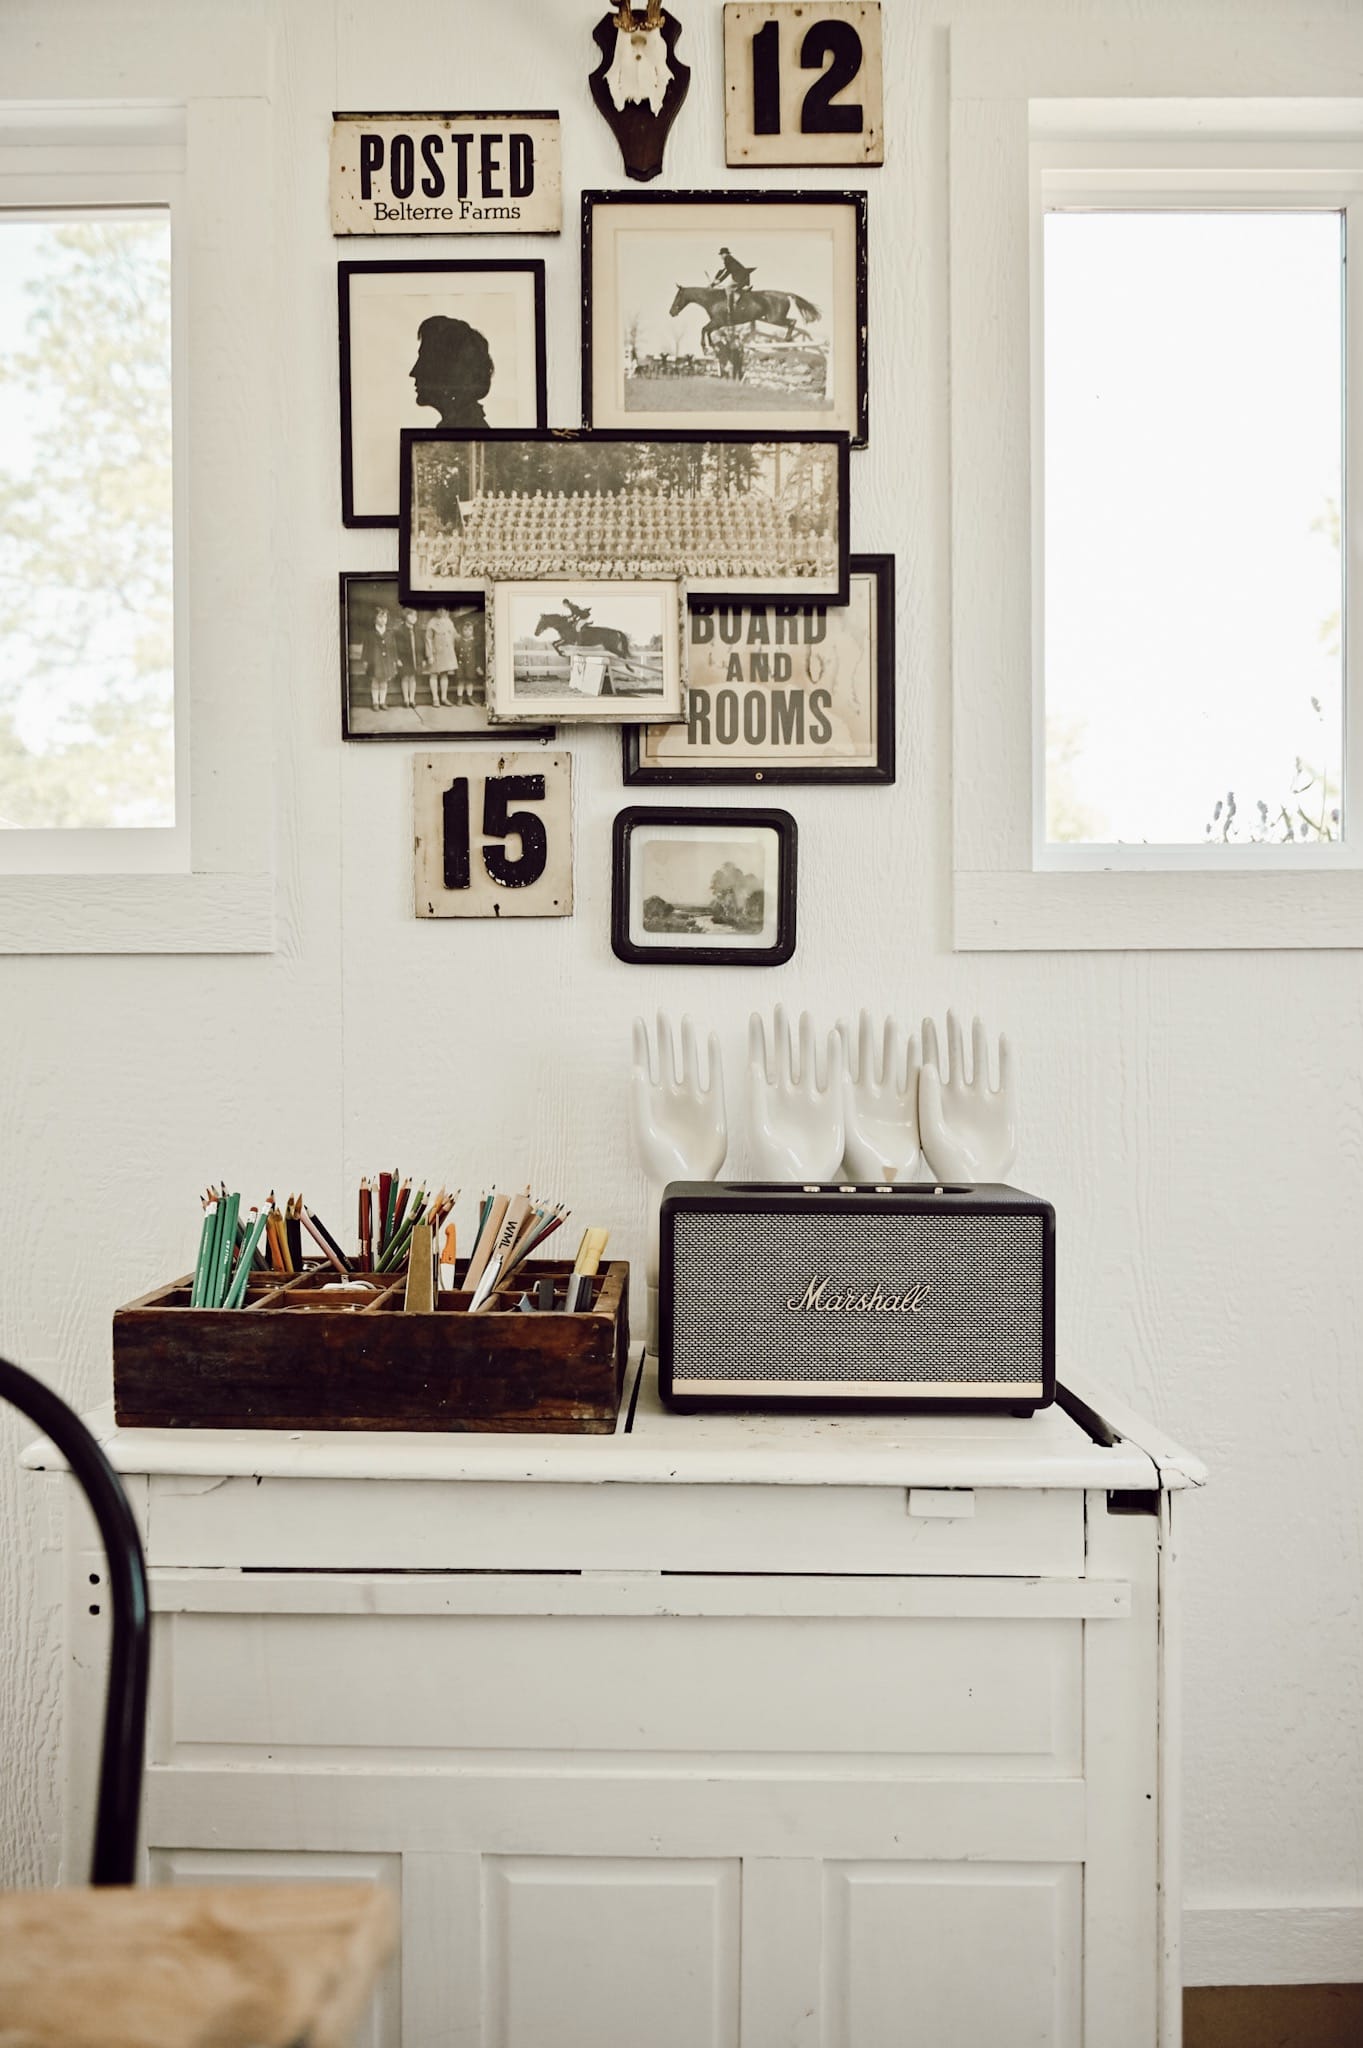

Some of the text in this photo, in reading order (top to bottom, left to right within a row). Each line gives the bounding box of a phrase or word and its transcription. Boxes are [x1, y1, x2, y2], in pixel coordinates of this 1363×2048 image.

[752, 19, 864, 135] 12
[360, 133, 535, 200] POSTED
[373, 200, 521, 221] Belterre Farms
[691, 606, 827, 645] BOARD
[726, 653, 792, 682] AND
[688, 689, 833, 745] ROOMS
[442, 774, 547, 889] 15
[786, 1274, 931, 1312] Marshall
